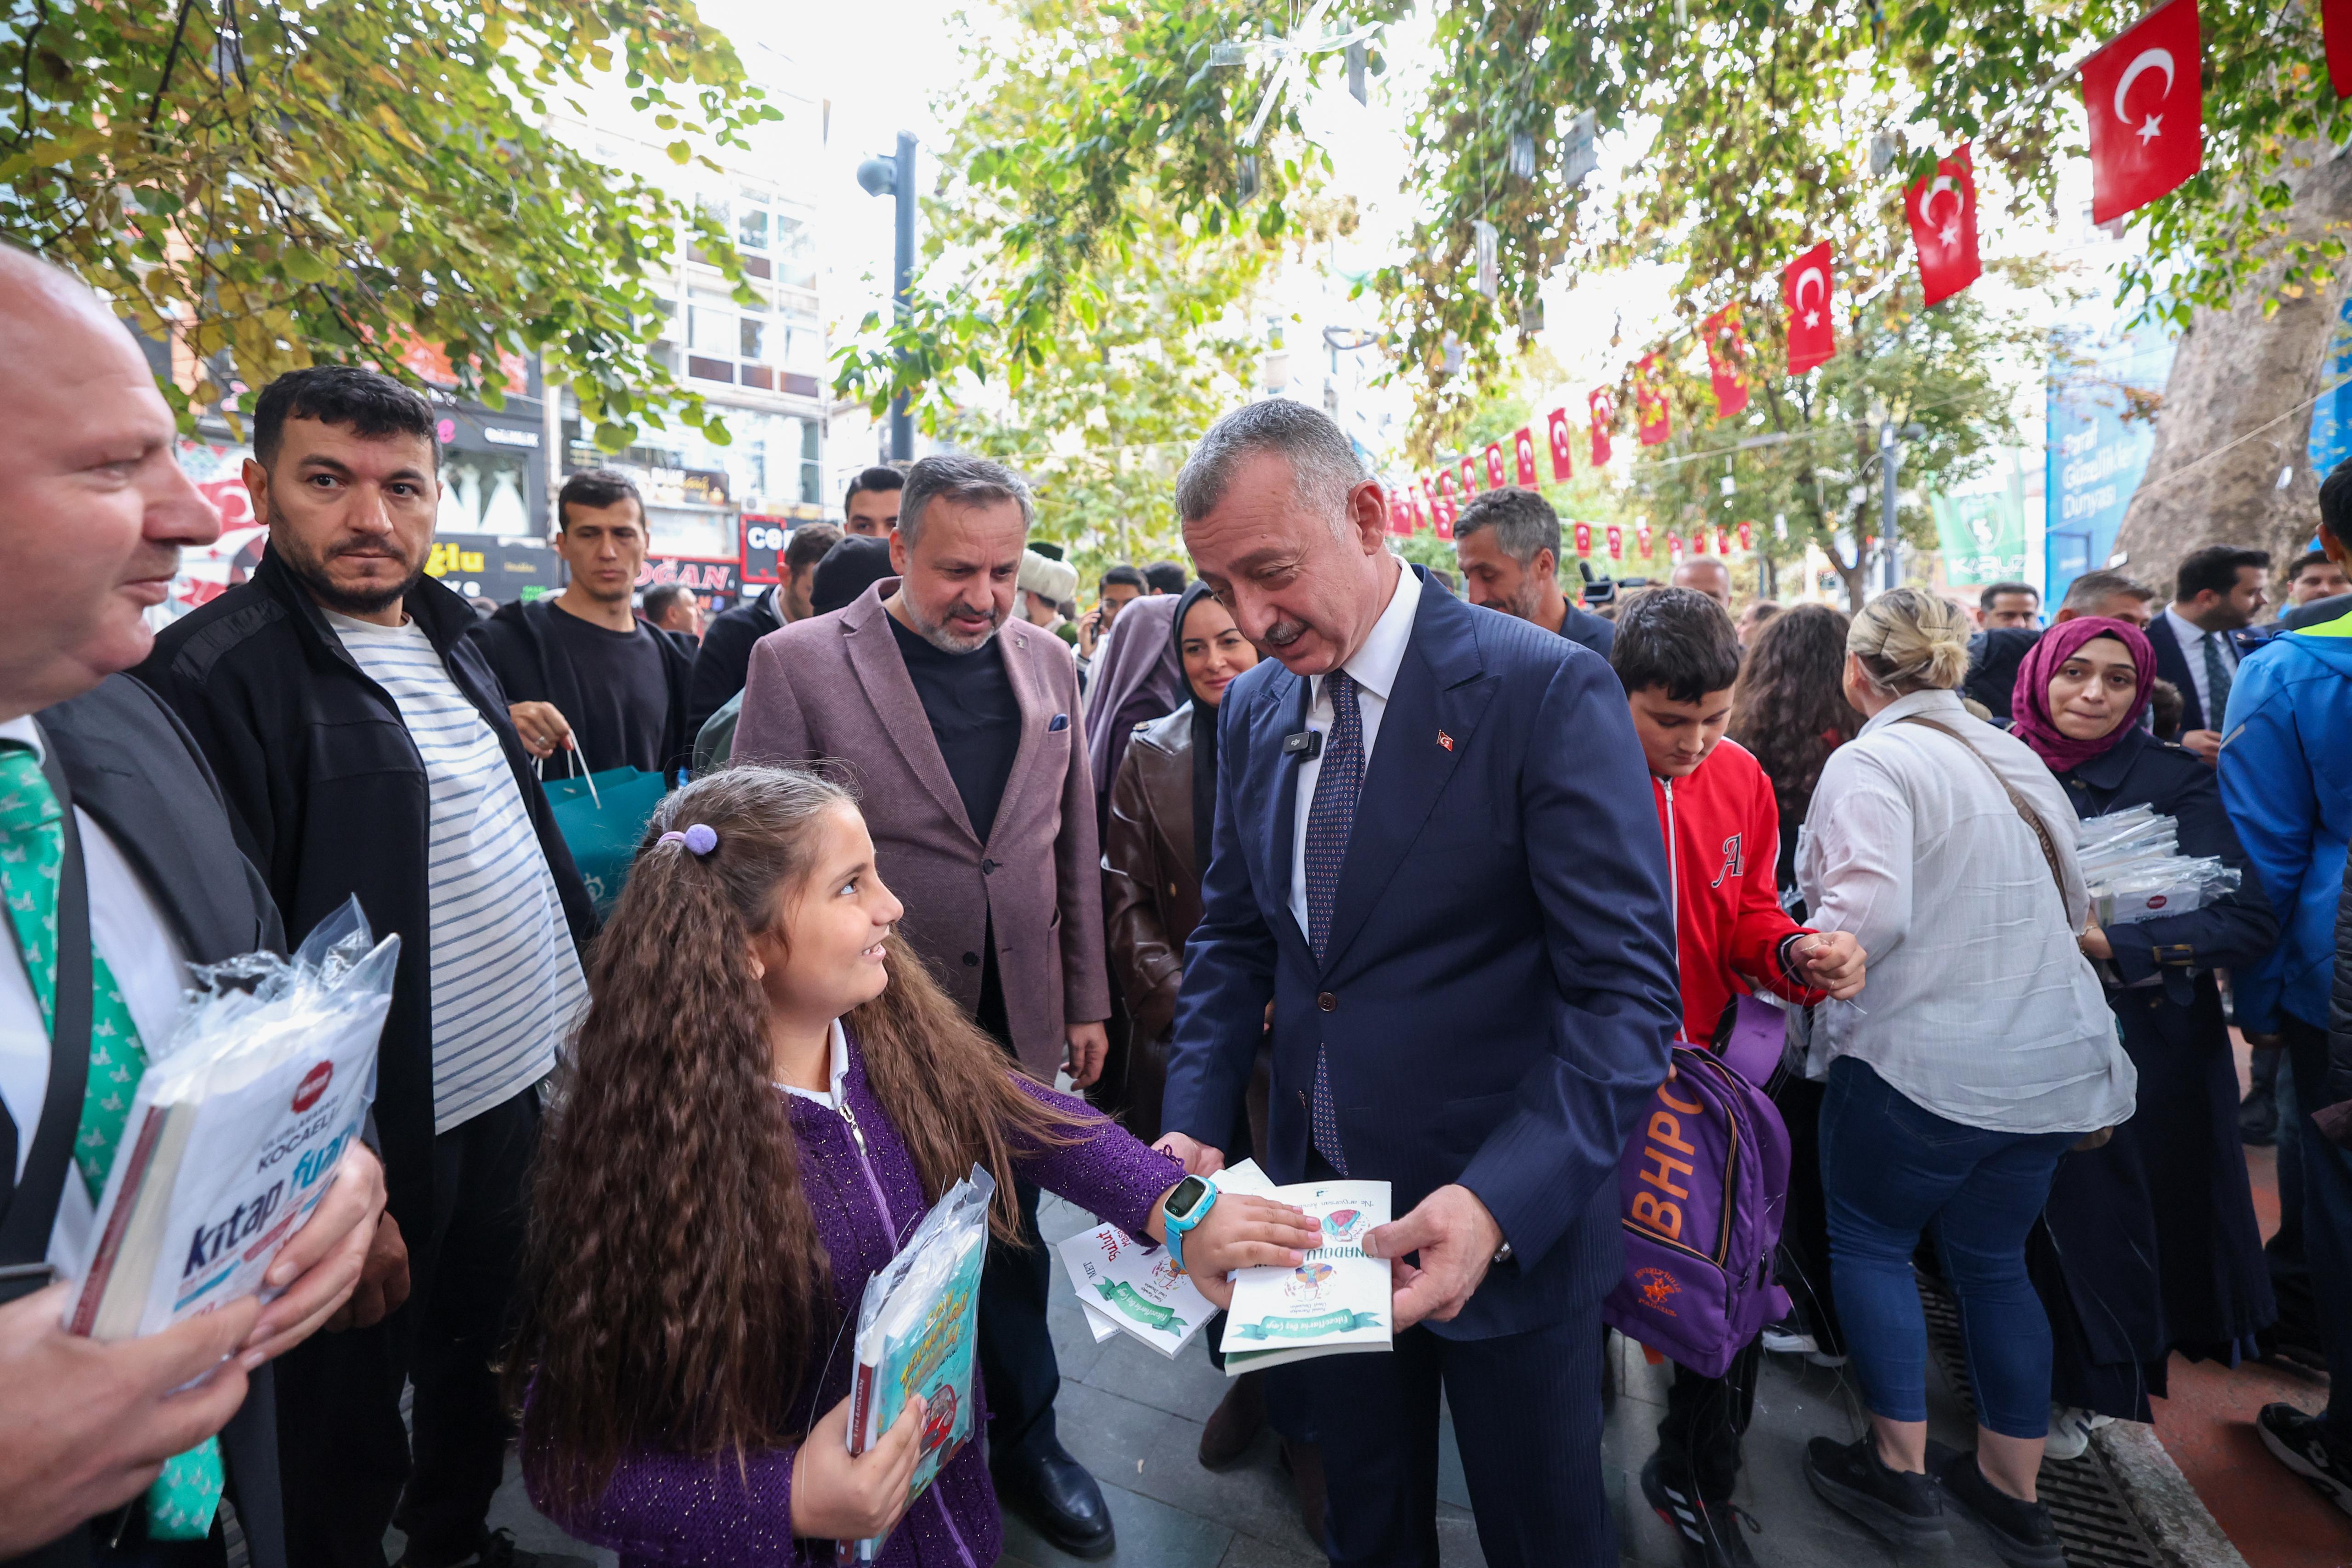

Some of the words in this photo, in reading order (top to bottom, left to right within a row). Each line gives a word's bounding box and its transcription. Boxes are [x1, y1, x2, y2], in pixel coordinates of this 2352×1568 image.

[2063, 439, 2138, 489] Güzellikler
[2063, 484, 2117, 519] Dünyası
[1711, 832, 1744, 888] A
[1631, 1080, 1704, 1240] BHPC
[183, 1179, 284, 1279] kitap
[1096, 1230, 1121, 1262] Bulut
[1083, 1262, 1097, 1280] MET
[1306, 1246, 1374, 1262] NADOLU
